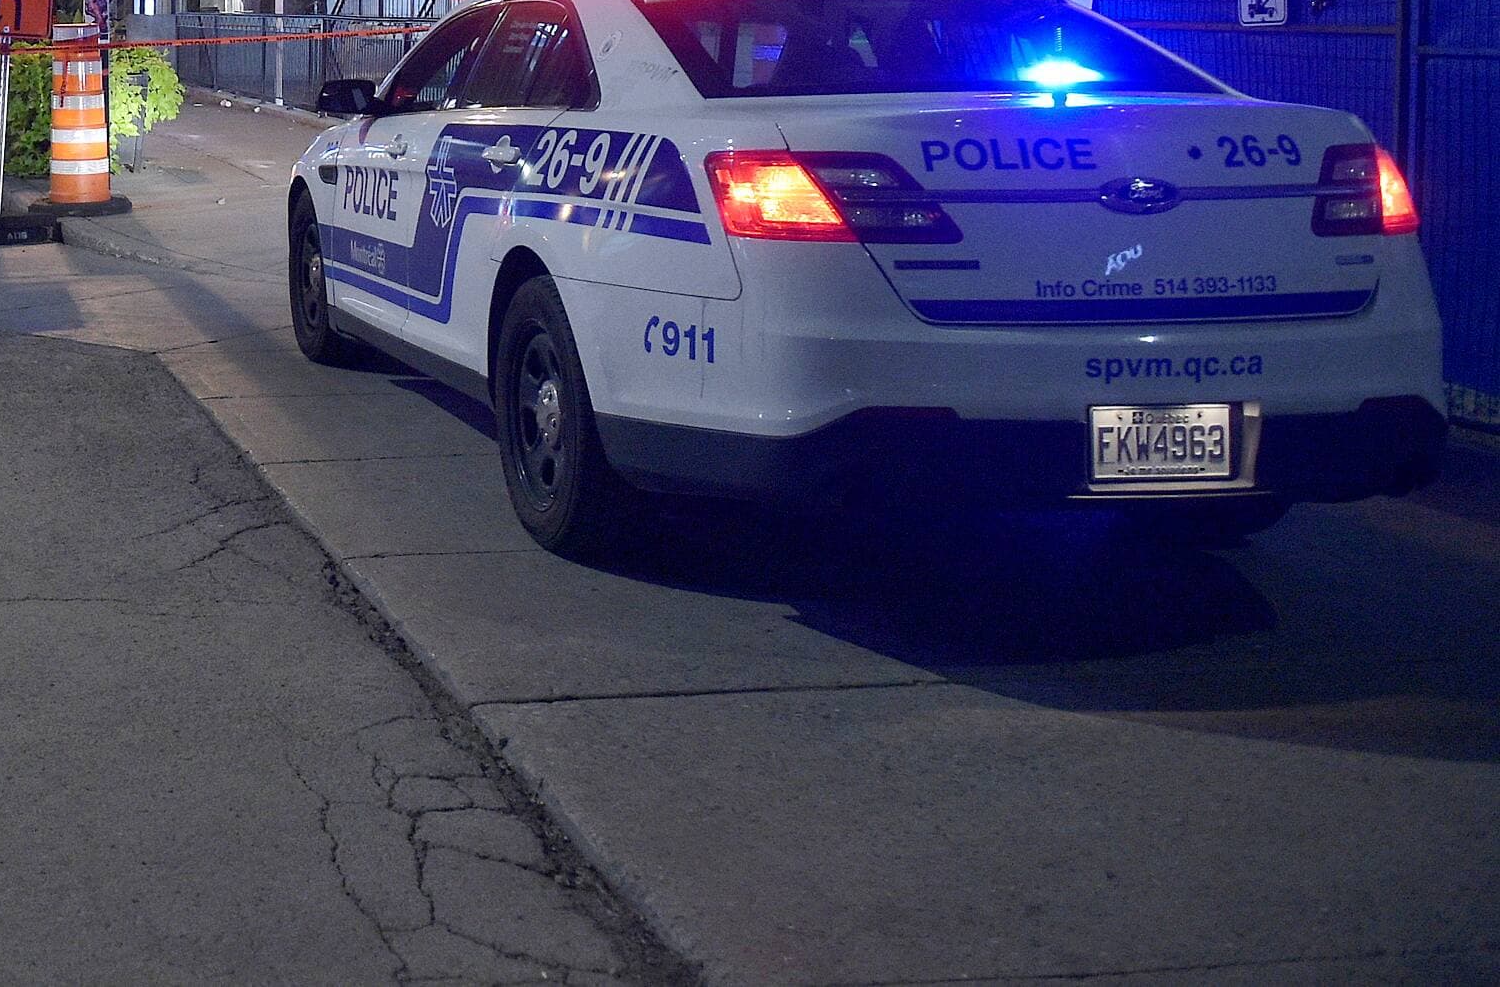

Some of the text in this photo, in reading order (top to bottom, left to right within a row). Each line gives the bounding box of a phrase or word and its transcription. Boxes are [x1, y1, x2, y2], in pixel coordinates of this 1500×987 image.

[530, 129, 611, 195] 26-9
[921, 133, 1301, 172] POLICE 26-9
[343, 165, 398, 221] POLICE
[1036, 275, 1277, 298] Info Crime 514 393-1133
[662, 320, 715, 364] 911
[1085, 354, 1263, 384] spvm.qc.ca
[1097, 424, 1225, 464] FKW4963
